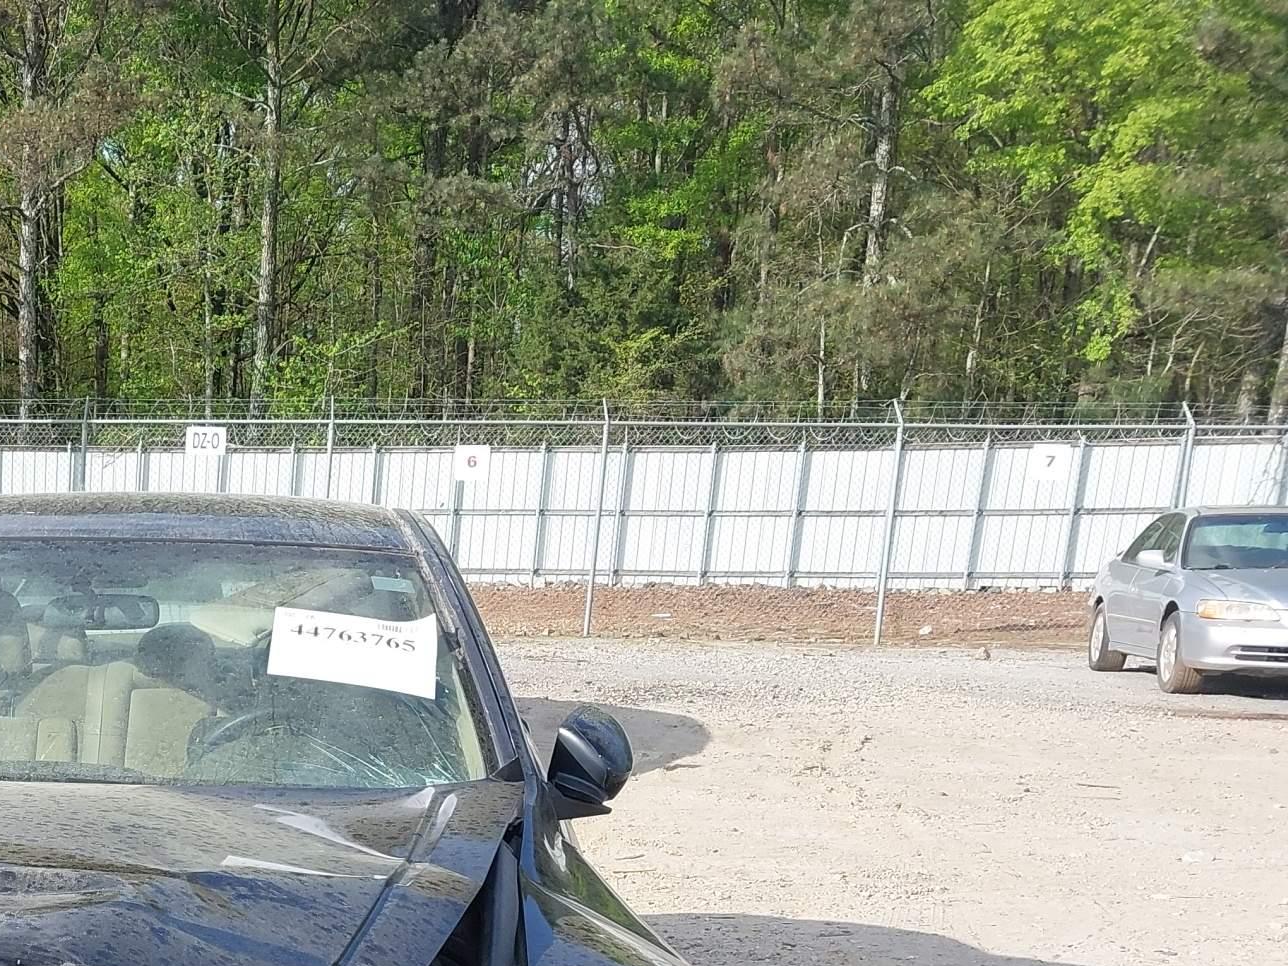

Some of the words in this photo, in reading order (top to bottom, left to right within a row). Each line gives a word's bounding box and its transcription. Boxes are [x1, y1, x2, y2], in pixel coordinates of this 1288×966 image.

[467, 455, 478, 468] 6
[1045, 455, 1057, 467] 7
[290, 623, 417, 653] 44763765
